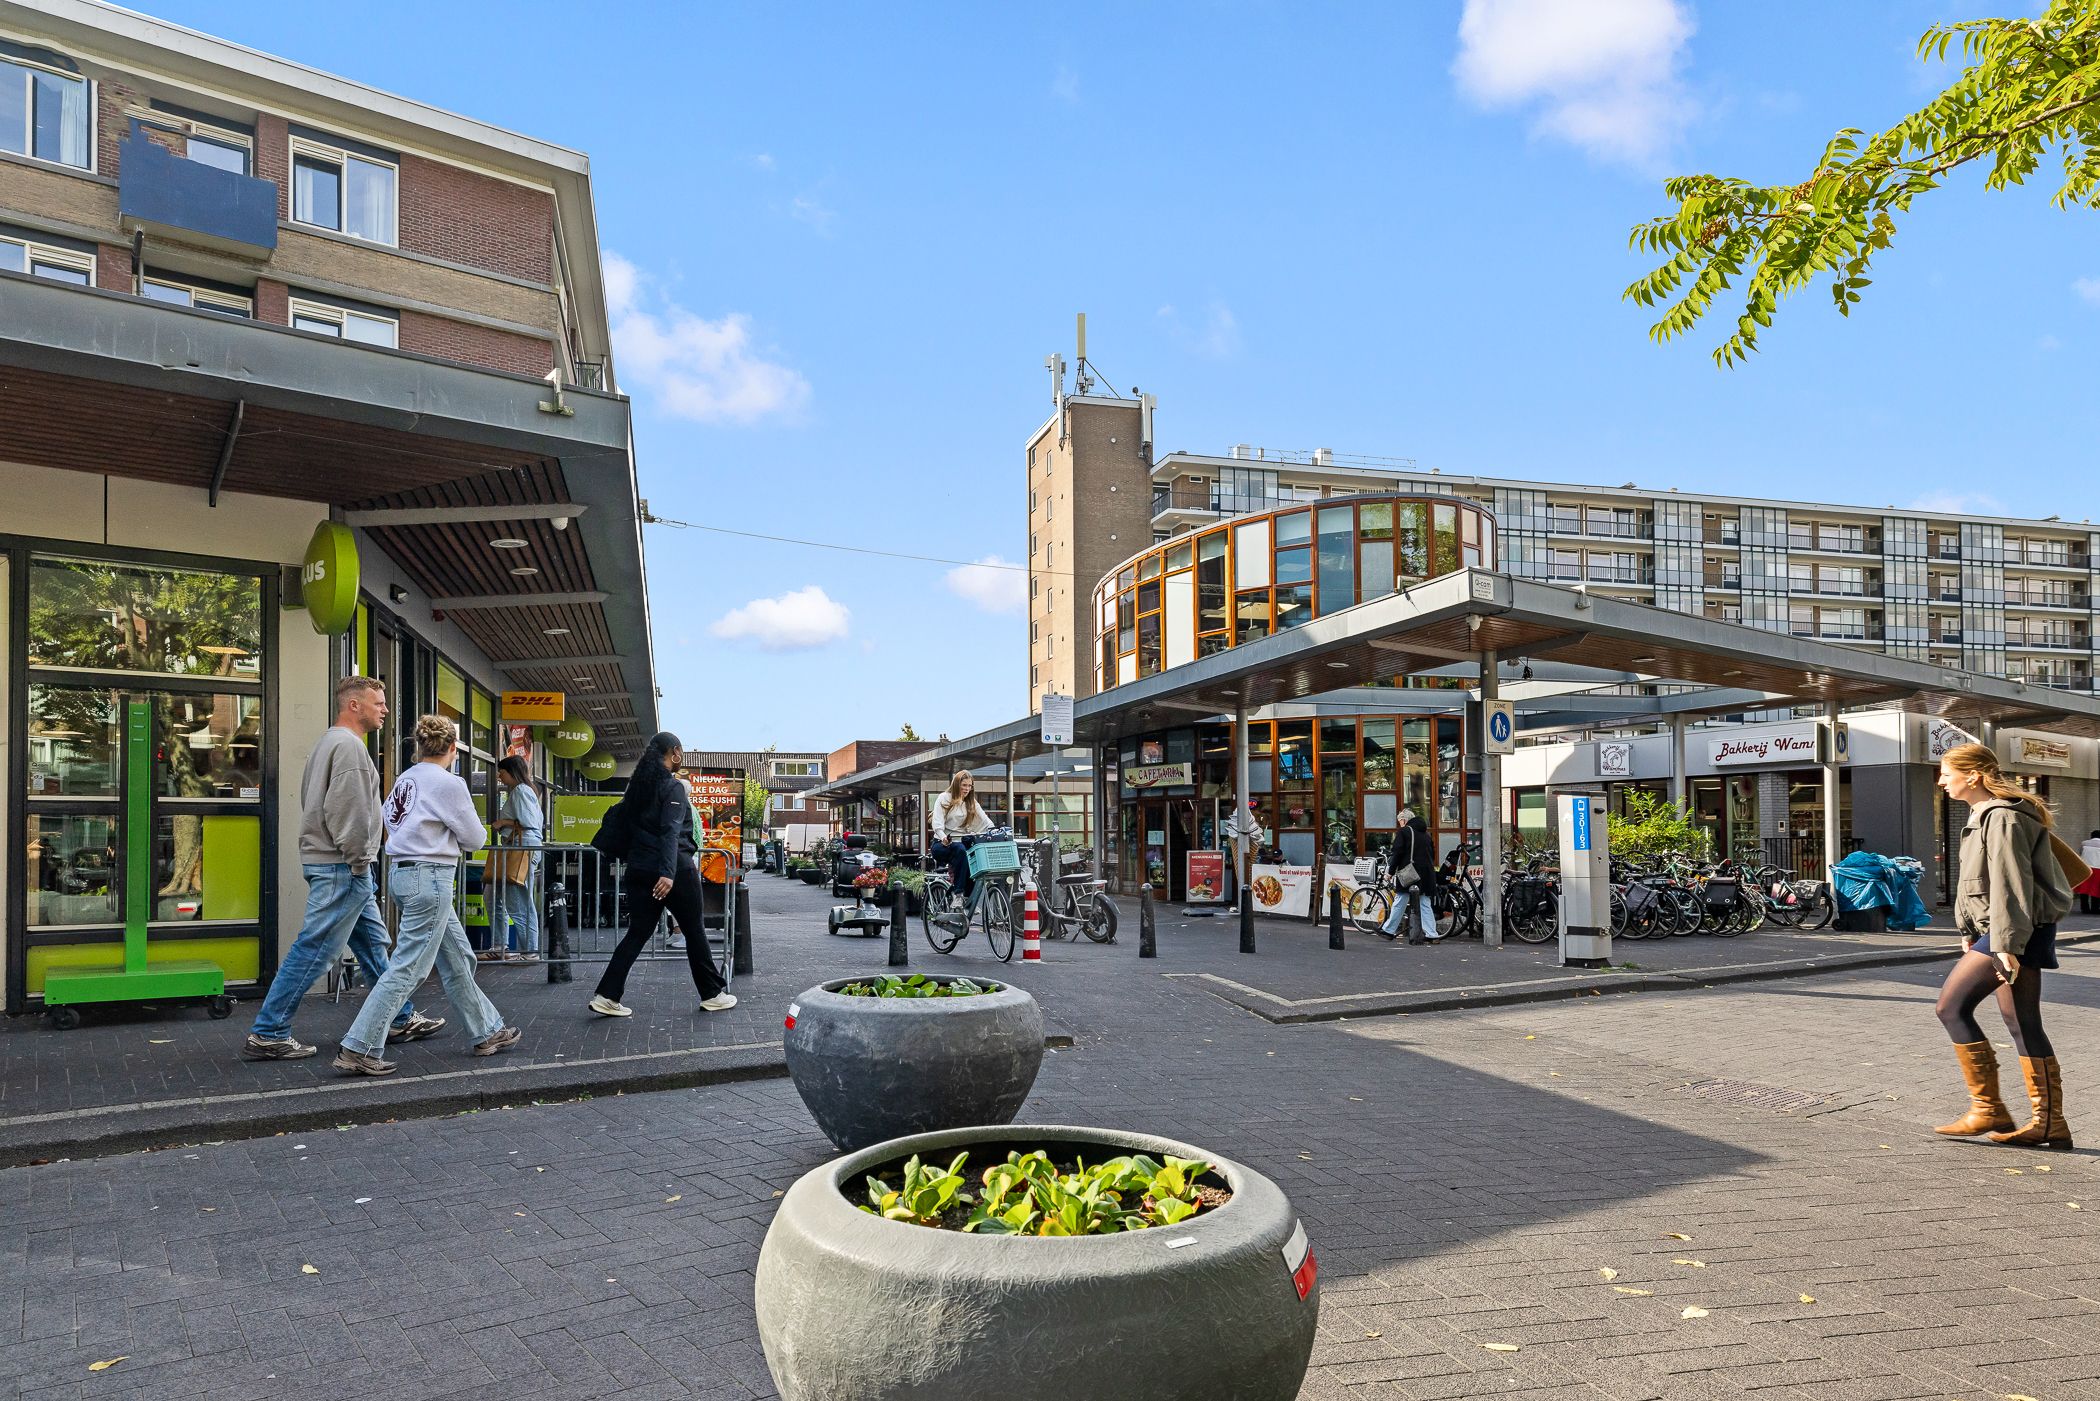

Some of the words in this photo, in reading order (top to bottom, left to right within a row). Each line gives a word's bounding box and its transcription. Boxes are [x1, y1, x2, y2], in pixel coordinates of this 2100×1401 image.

[510, 696, 555, 706] DHL
[557, 730, 589, 741] PLUS
[1715, 742, 1769, 762] Bakkerij
[690, 786, 707, 794] LKE
[708, 786, 728, 794] DAG
[688, 796, 708, 804] ERSE
[710, 796, 736, 804] SUSHI
[577, 817, 603, 825] Winkel
[1578, 812, 1586, 849] 30163
